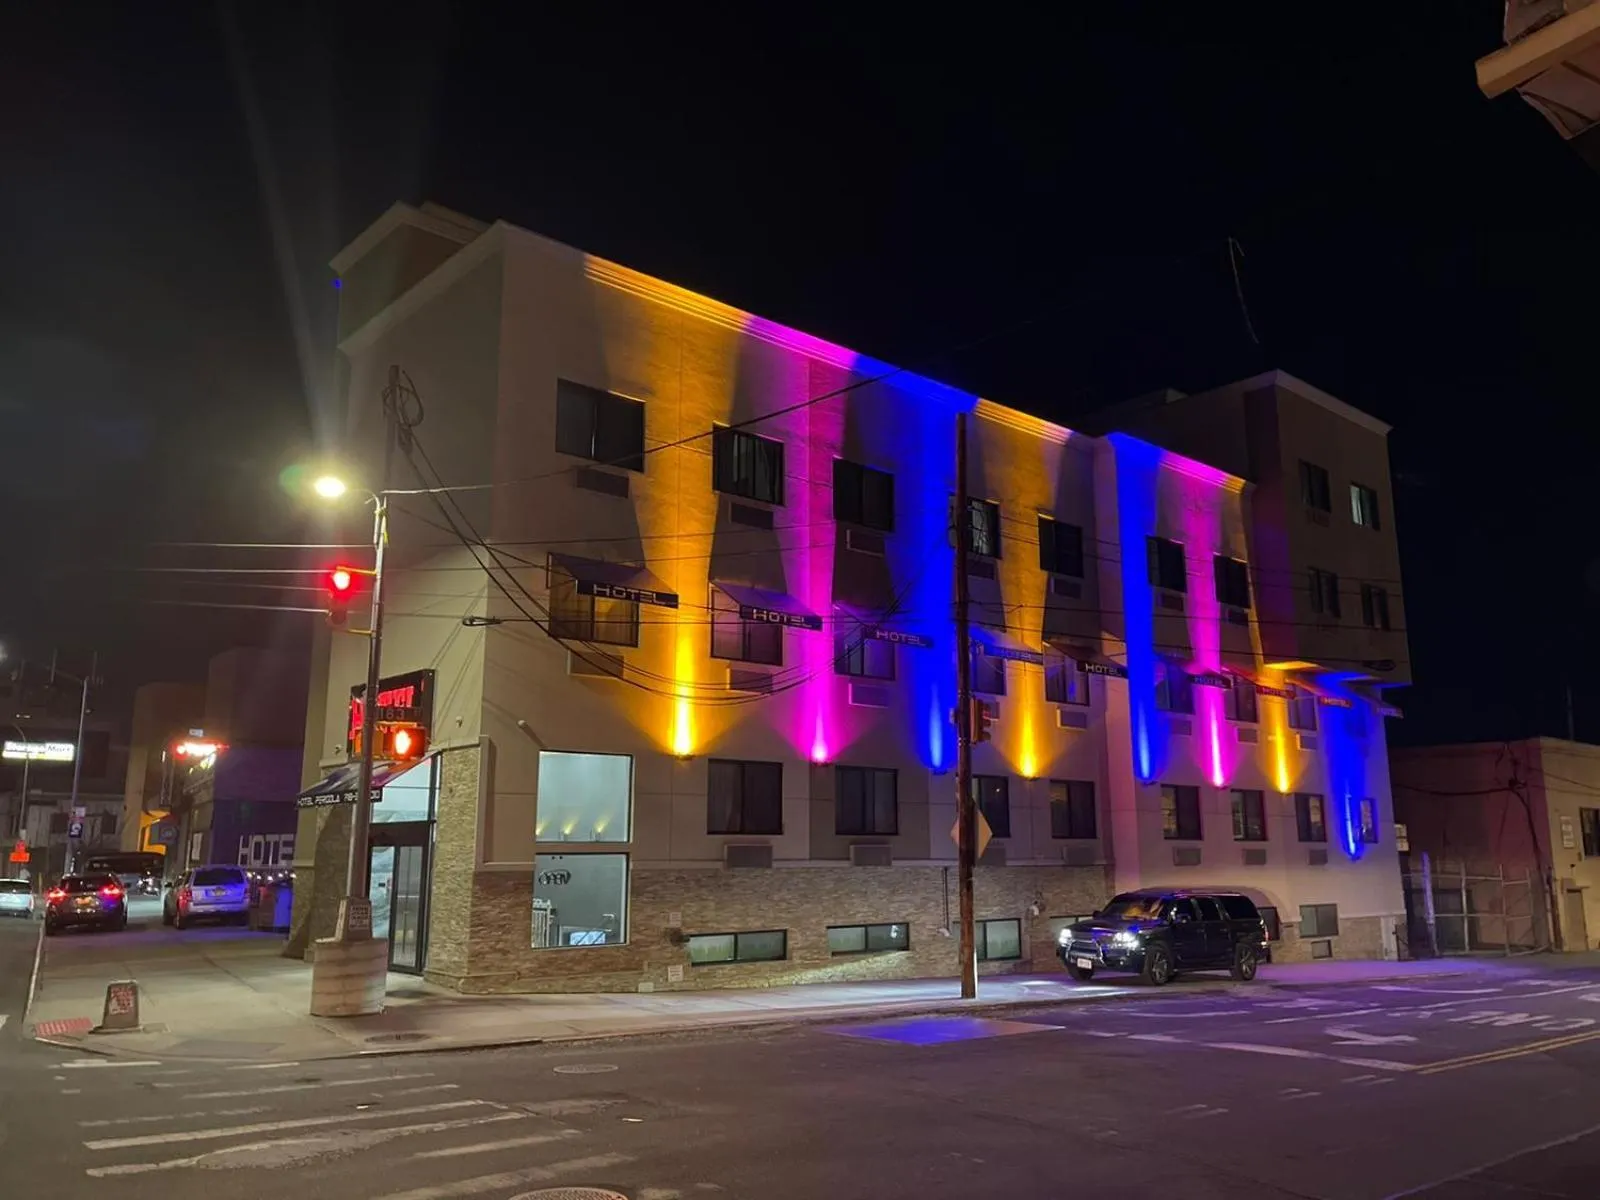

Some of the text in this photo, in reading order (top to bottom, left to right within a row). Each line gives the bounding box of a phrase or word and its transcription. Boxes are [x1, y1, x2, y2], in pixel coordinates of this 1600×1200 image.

[593, 583, 667, 605] HOTEL
[752, 608, 812, 628] HOTEL
[875, 630, 926, 646] HOTEL
[1085, 662, 1122, 676] HOTEL
